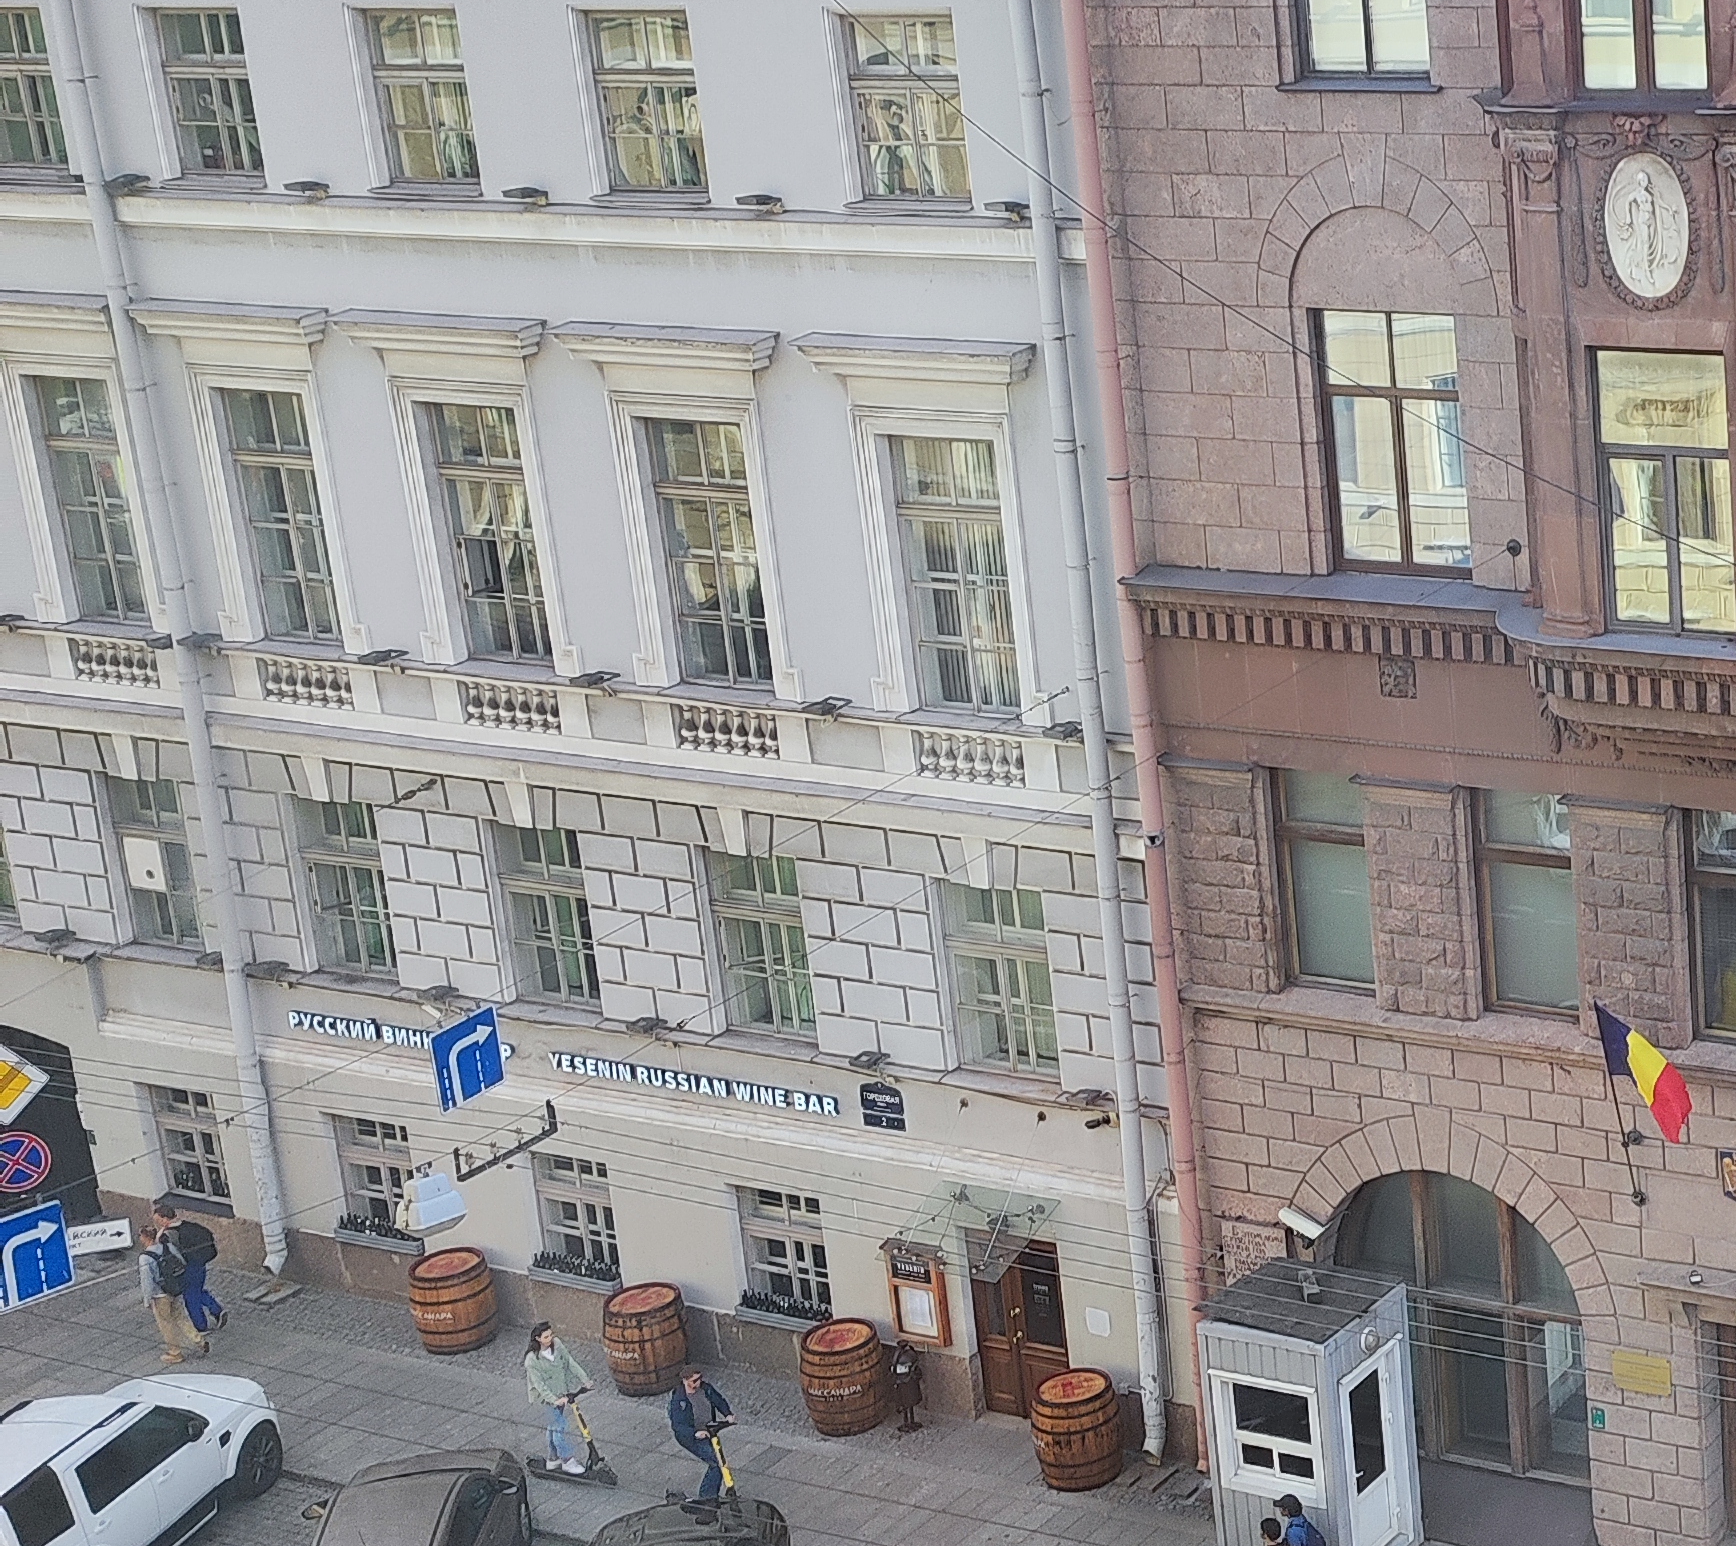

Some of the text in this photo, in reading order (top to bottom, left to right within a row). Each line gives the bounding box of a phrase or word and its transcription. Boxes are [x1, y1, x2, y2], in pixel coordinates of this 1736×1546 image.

[288, 1011, 432, 1050] РУССКИЙ ВИНН
[547, 1052, 633, 1083] YESENIN
[637, 1066, 728, 1099] RUSSIAN
[731, 1081, 788, 1109] WINE
[793, 1091, 839, 1117] BAR
[880, 1116, 887, 1126] 2
[69, 1228, 108, 1241] ВСКИЙ
